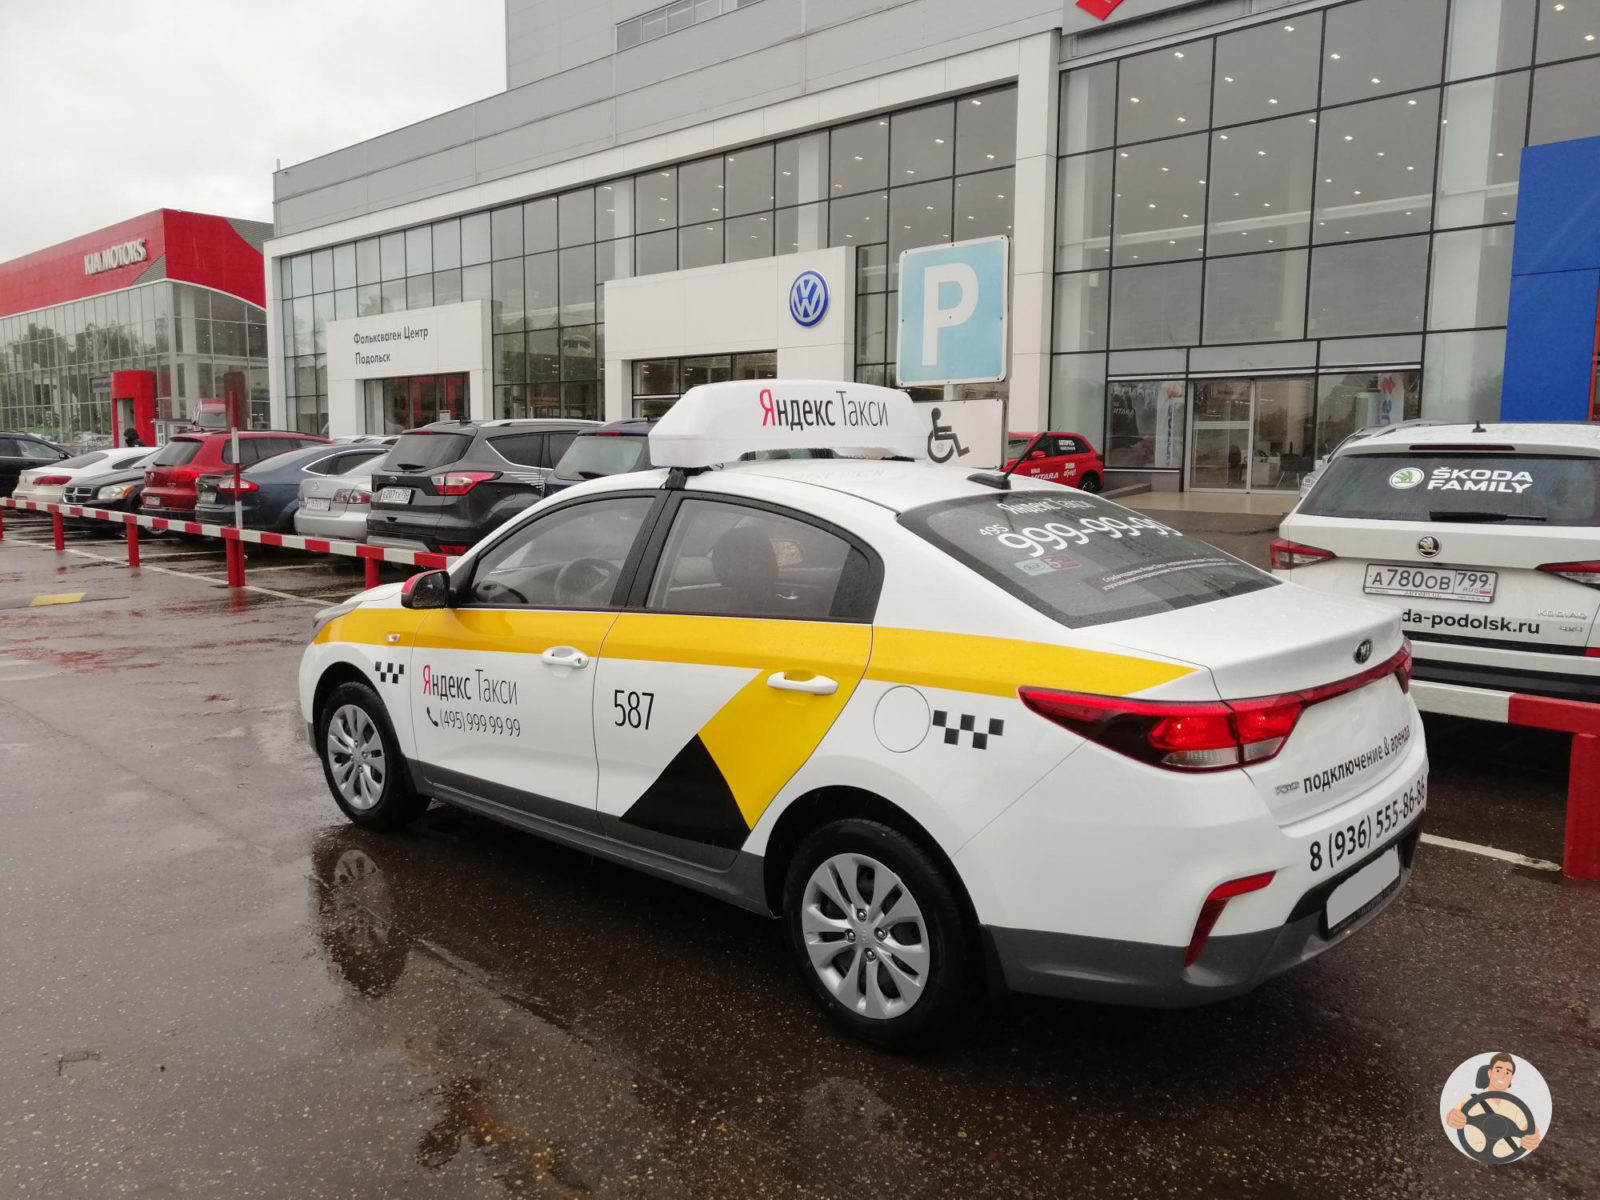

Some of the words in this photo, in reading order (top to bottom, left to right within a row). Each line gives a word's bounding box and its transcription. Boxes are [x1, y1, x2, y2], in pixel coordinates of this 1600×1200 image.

[84, 252, 104, 275] KIA
[103, 239, 147, 270] MOTORS
[922, 263, 979, 366] P
[353, 331, 402, 344] Фольксваген
[403, 325, 429, 341] Центр
[355, 352, 391, 365] Подольск
[759, 388, 836, 431] Яндекс
[835, 390, 889, 427] Такси
[1427, 480, 1533, 494] FAMILY
[1431, 466, 1534, 483] ŠKODA
[979, 523, 1009, 537] 495
[1457, 572, 1490, 588] 799
[423, 664, 472, 701] Яндекс
[475, 668, 518, 705] Такси
[613, 689, 655, 730] 587
[1303, 744, 1383, 794] подключение
[1383, 736, 1391, 757] &
[1309, 840, 1323, 872] 8
[1328, 815, 1372, 869] (936)
